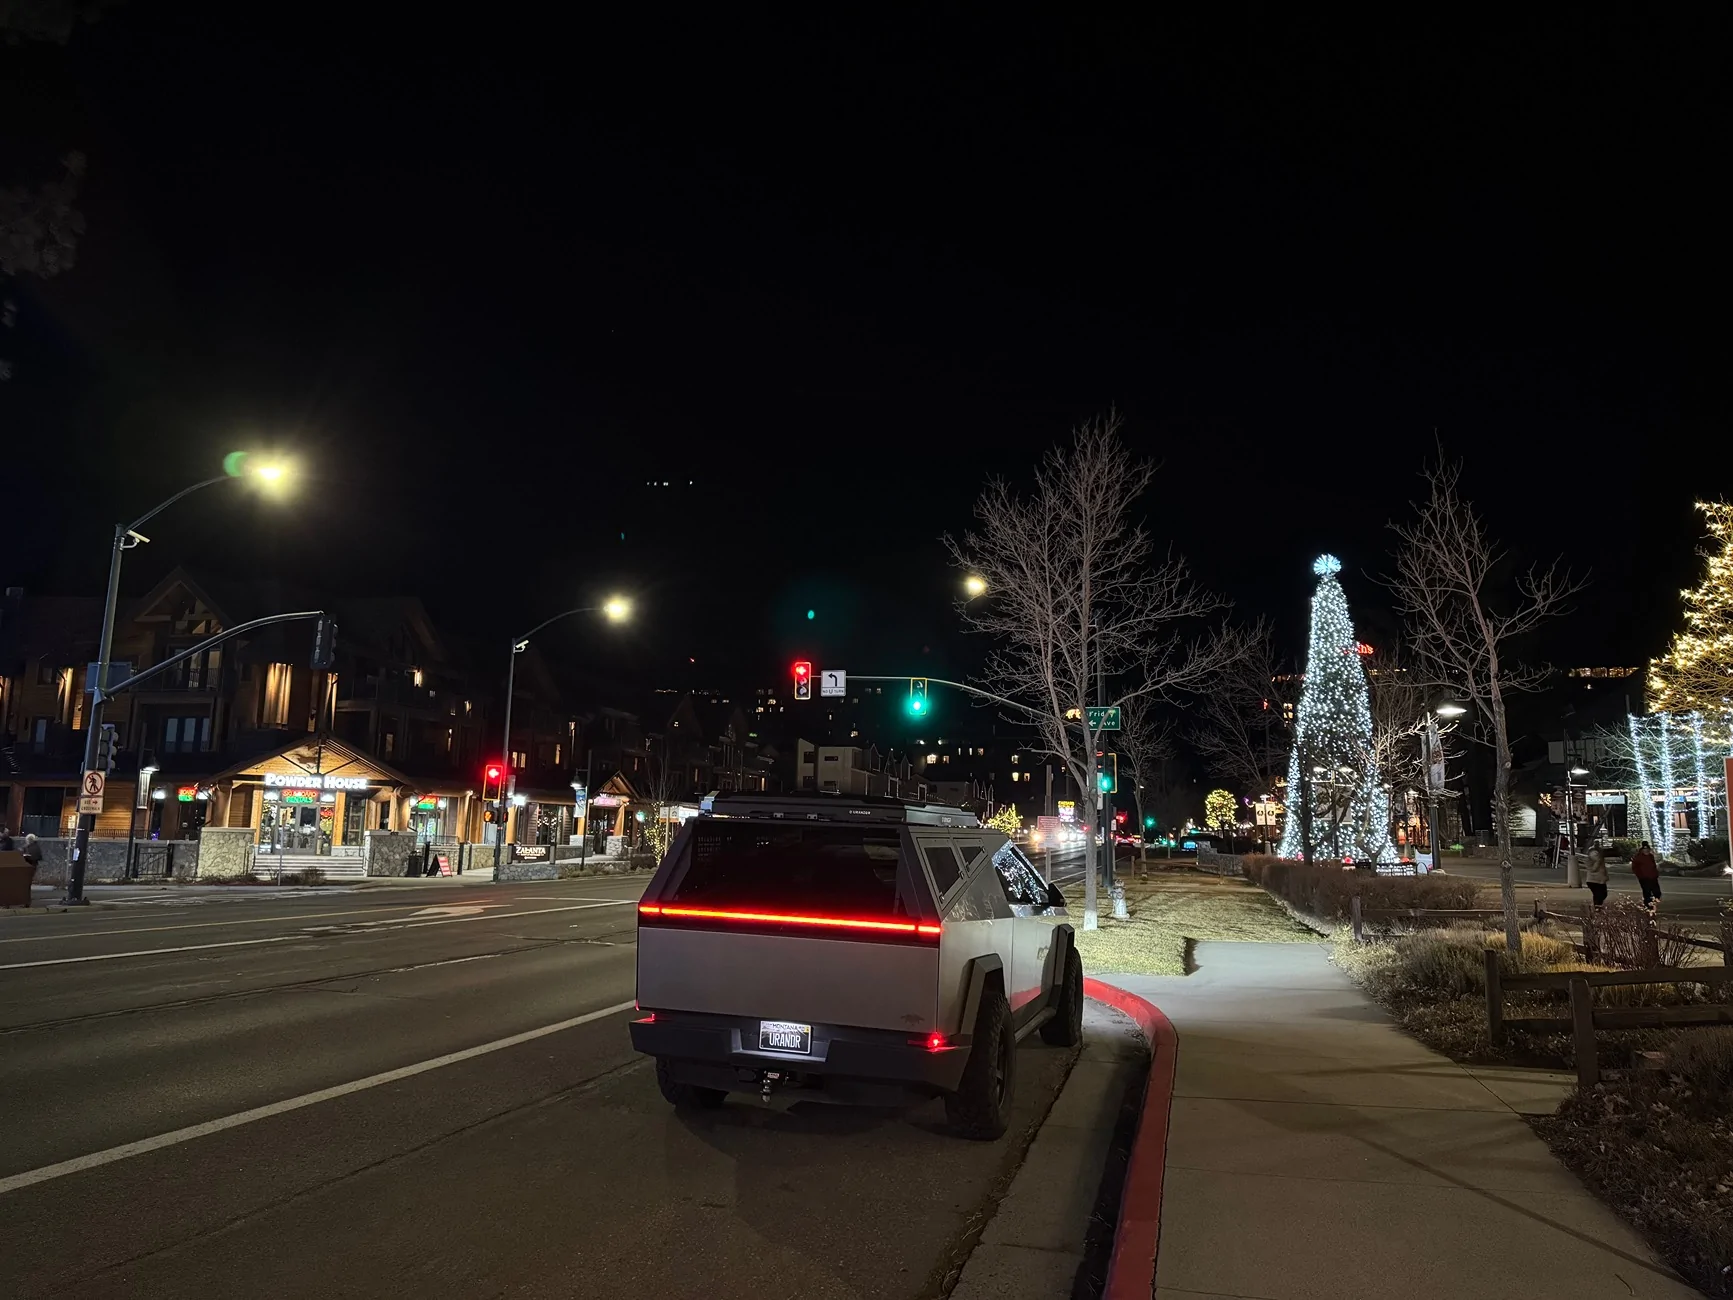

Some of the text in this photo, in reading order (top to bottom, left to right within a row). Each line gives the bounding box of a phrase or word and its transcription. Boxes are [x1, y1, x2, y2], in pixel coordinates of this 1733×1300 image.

[1089, 710, 1116, 719] Fridy
[265, 772, 367, 789] POWDER HOUSE
[769, 1032, 801, 1049] URANDR
